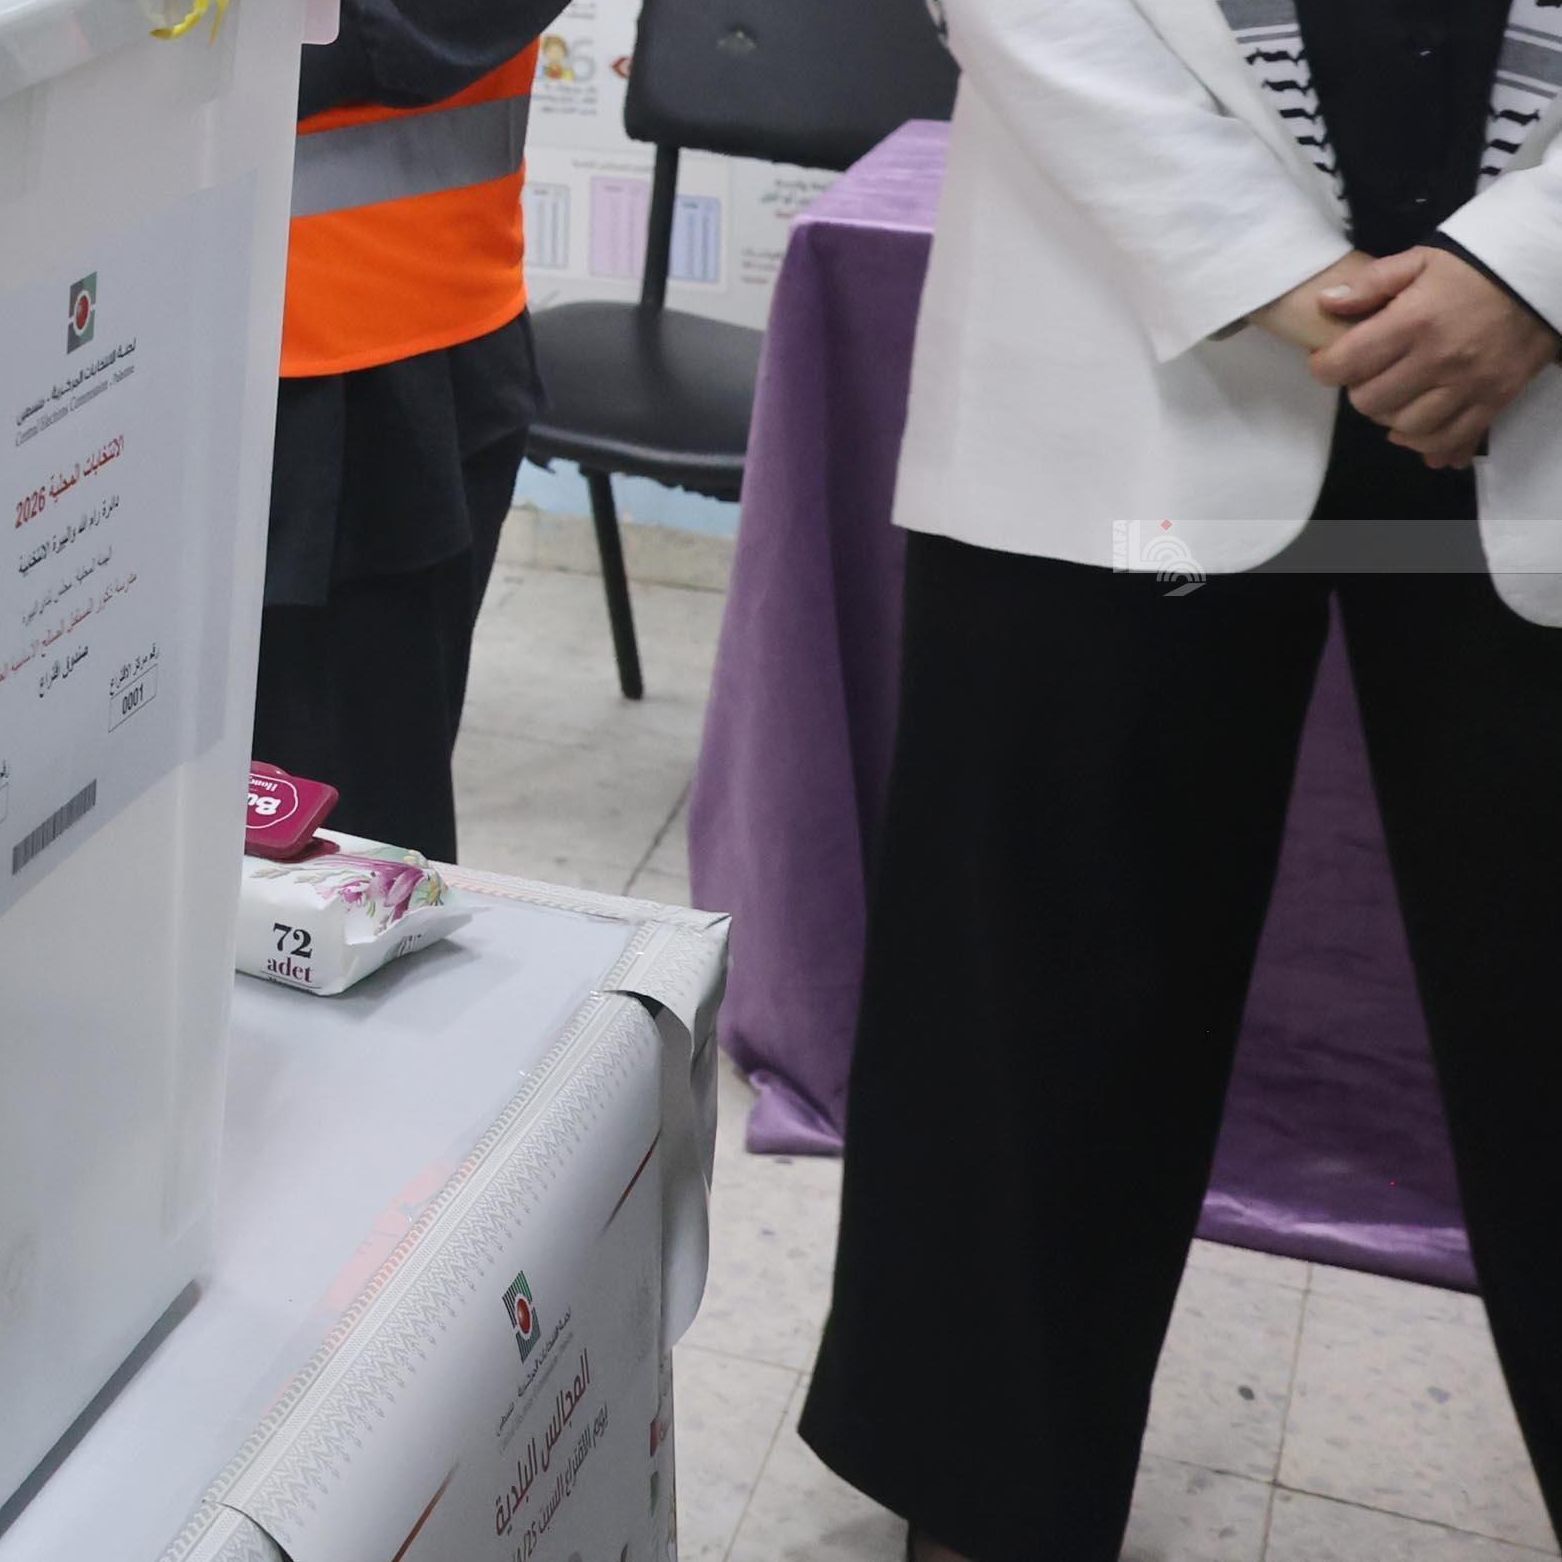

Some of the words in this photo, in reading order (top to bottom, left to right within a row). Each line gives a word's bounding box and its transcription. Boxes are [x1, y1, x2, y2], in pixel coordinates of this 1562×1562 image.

[83, 434, 125, 477] الانتخابات
[49, 462, 81, 504] المحلية
[15, 486, 46, 529] 2026
[62, 644, 89, 680] صندوق
[122, 683, 145, 715] 0001
[272, 922, 313, 959] 72
[267, 957, 313, 983] adet
[541, 1348, 590, 1472] المجالس
[591, 1401, 610, 1449] يوم
[565, 1425, 592, 1497] الاقتراع
[495, 1437, 538, 1536] البلدية
[538, 1474, 565, 1534] السبت
